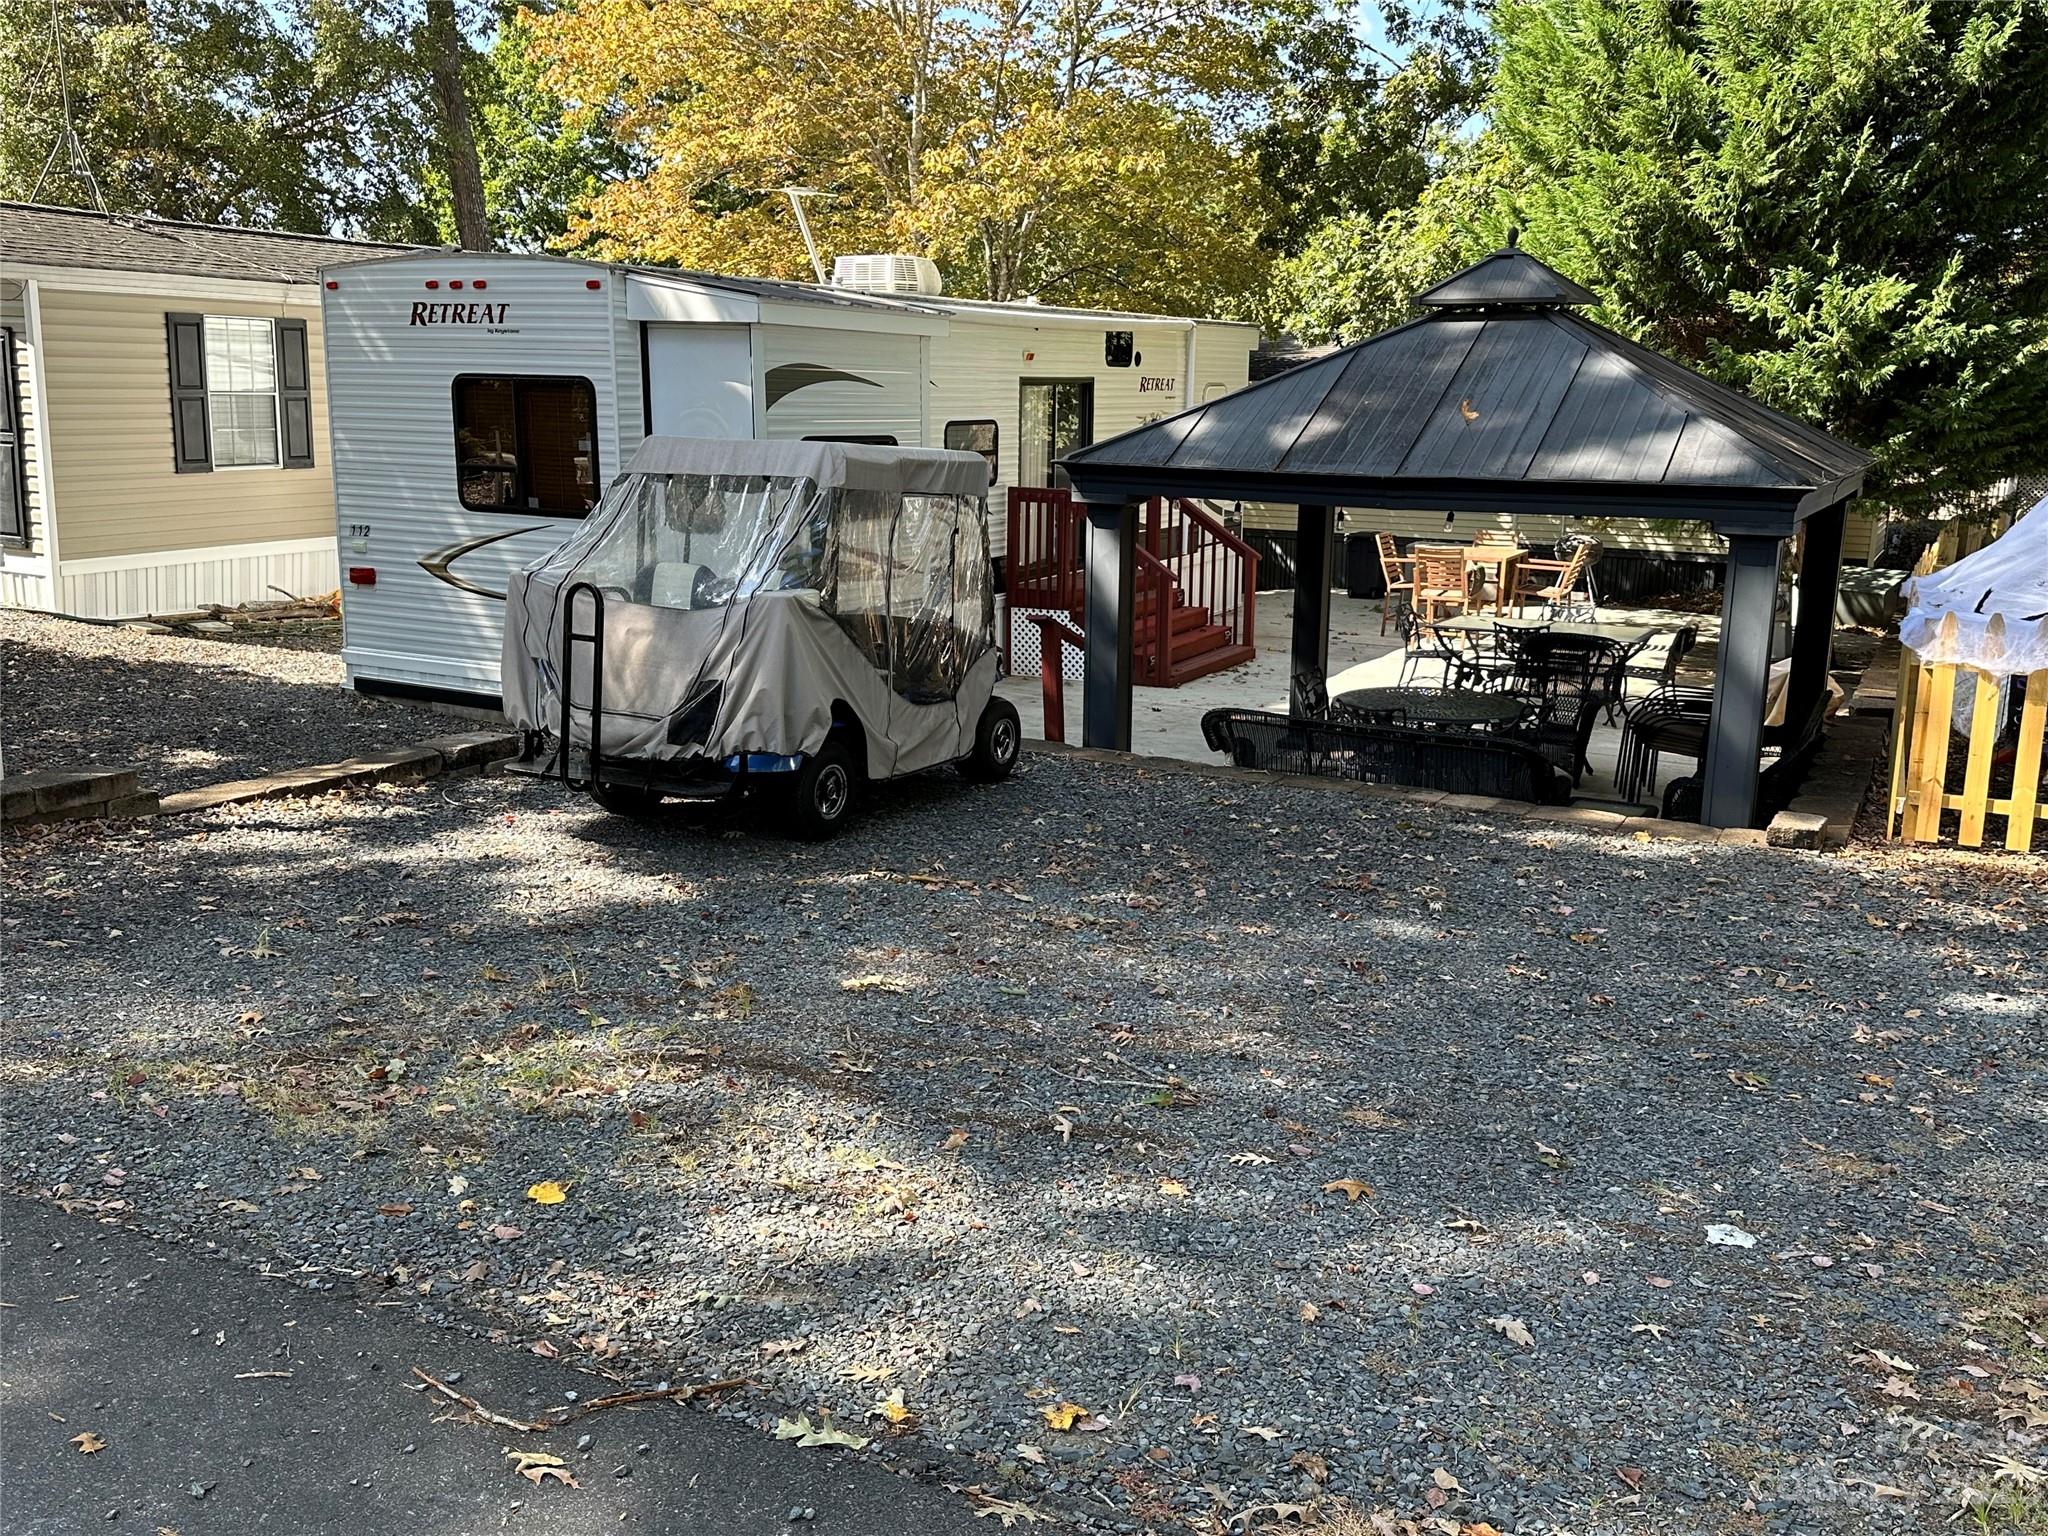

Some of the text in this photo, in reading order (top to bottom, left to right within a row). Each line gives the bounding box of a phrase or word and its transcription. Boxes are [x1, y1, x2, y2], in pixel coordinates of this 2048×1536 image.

[409, 301, 510, 326] RETREAT
[1139, 376, 1176, 392] RETREAT
[351, 524, 370, 537] 112
